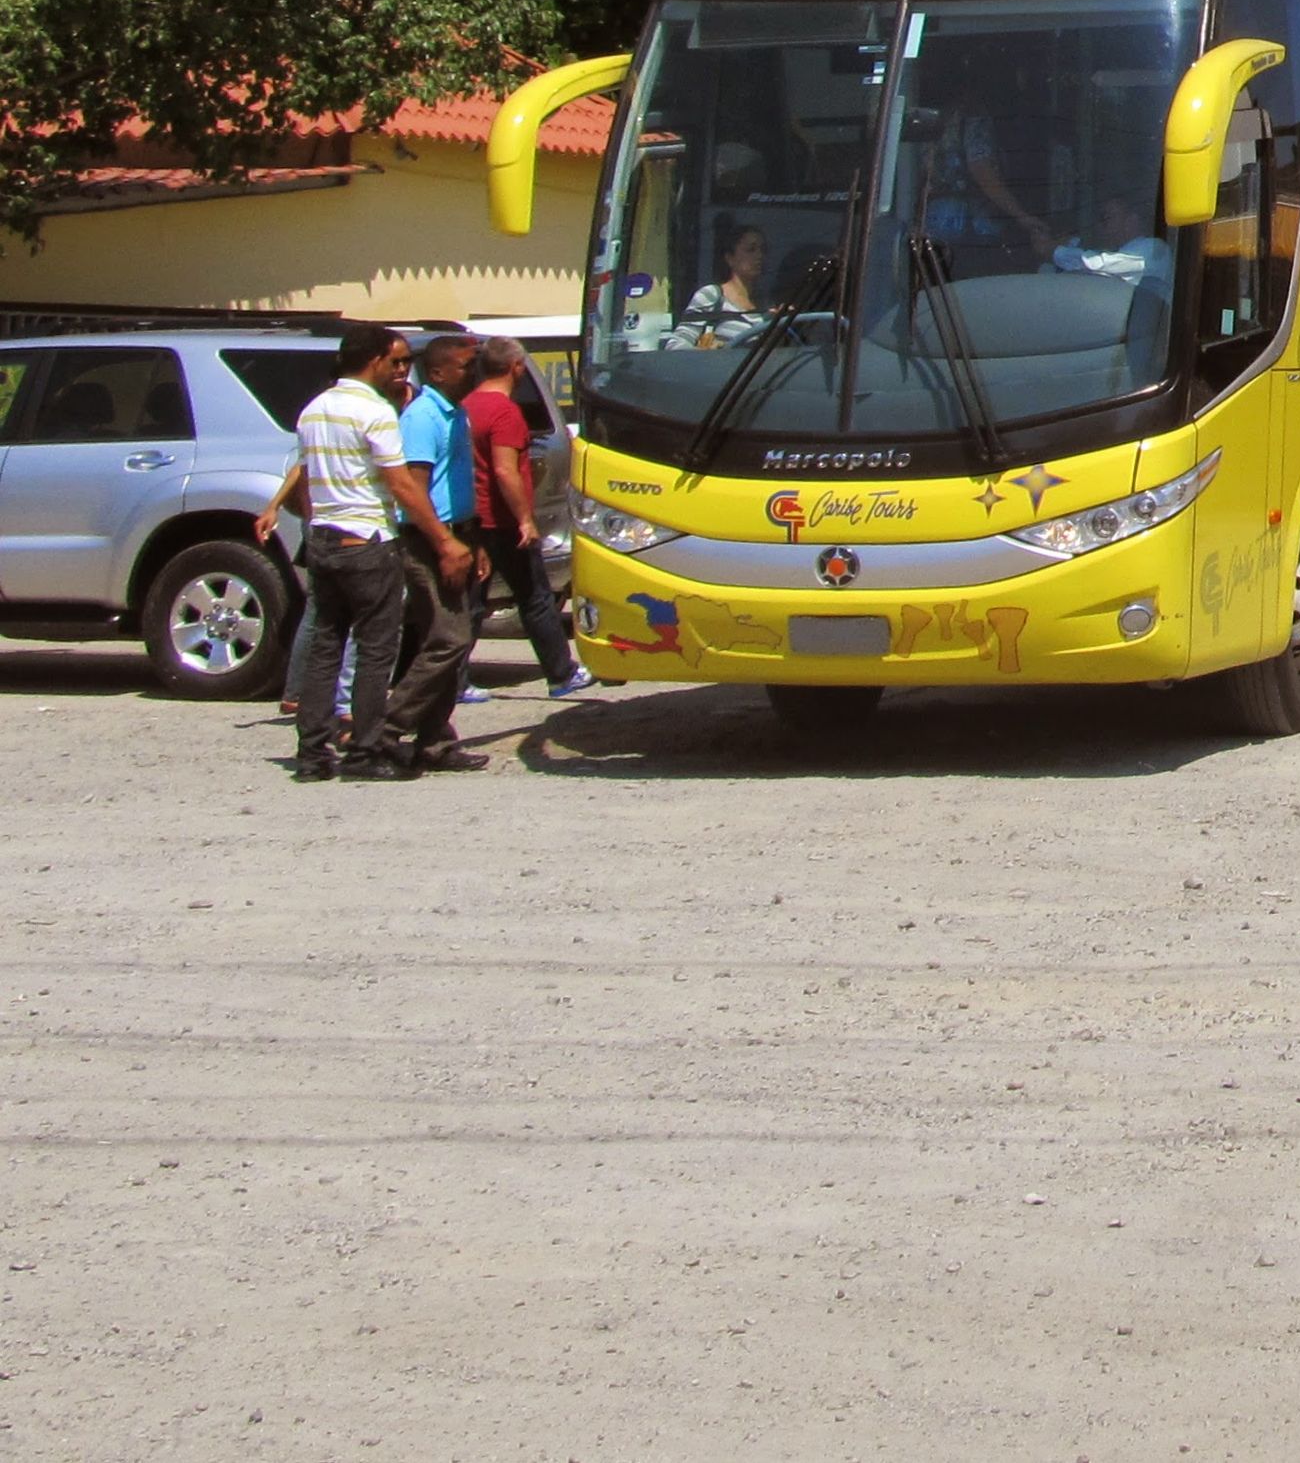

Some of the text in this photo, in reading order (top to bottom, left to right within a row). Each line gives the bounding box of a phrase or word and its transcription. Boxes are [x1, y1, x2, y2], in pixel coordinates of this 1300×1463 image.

[762, 449, 911, 470] Marcopolo
[608, 479, 662, 495] VOLVO
[809, 490, 918, 528] Caribe Tours
